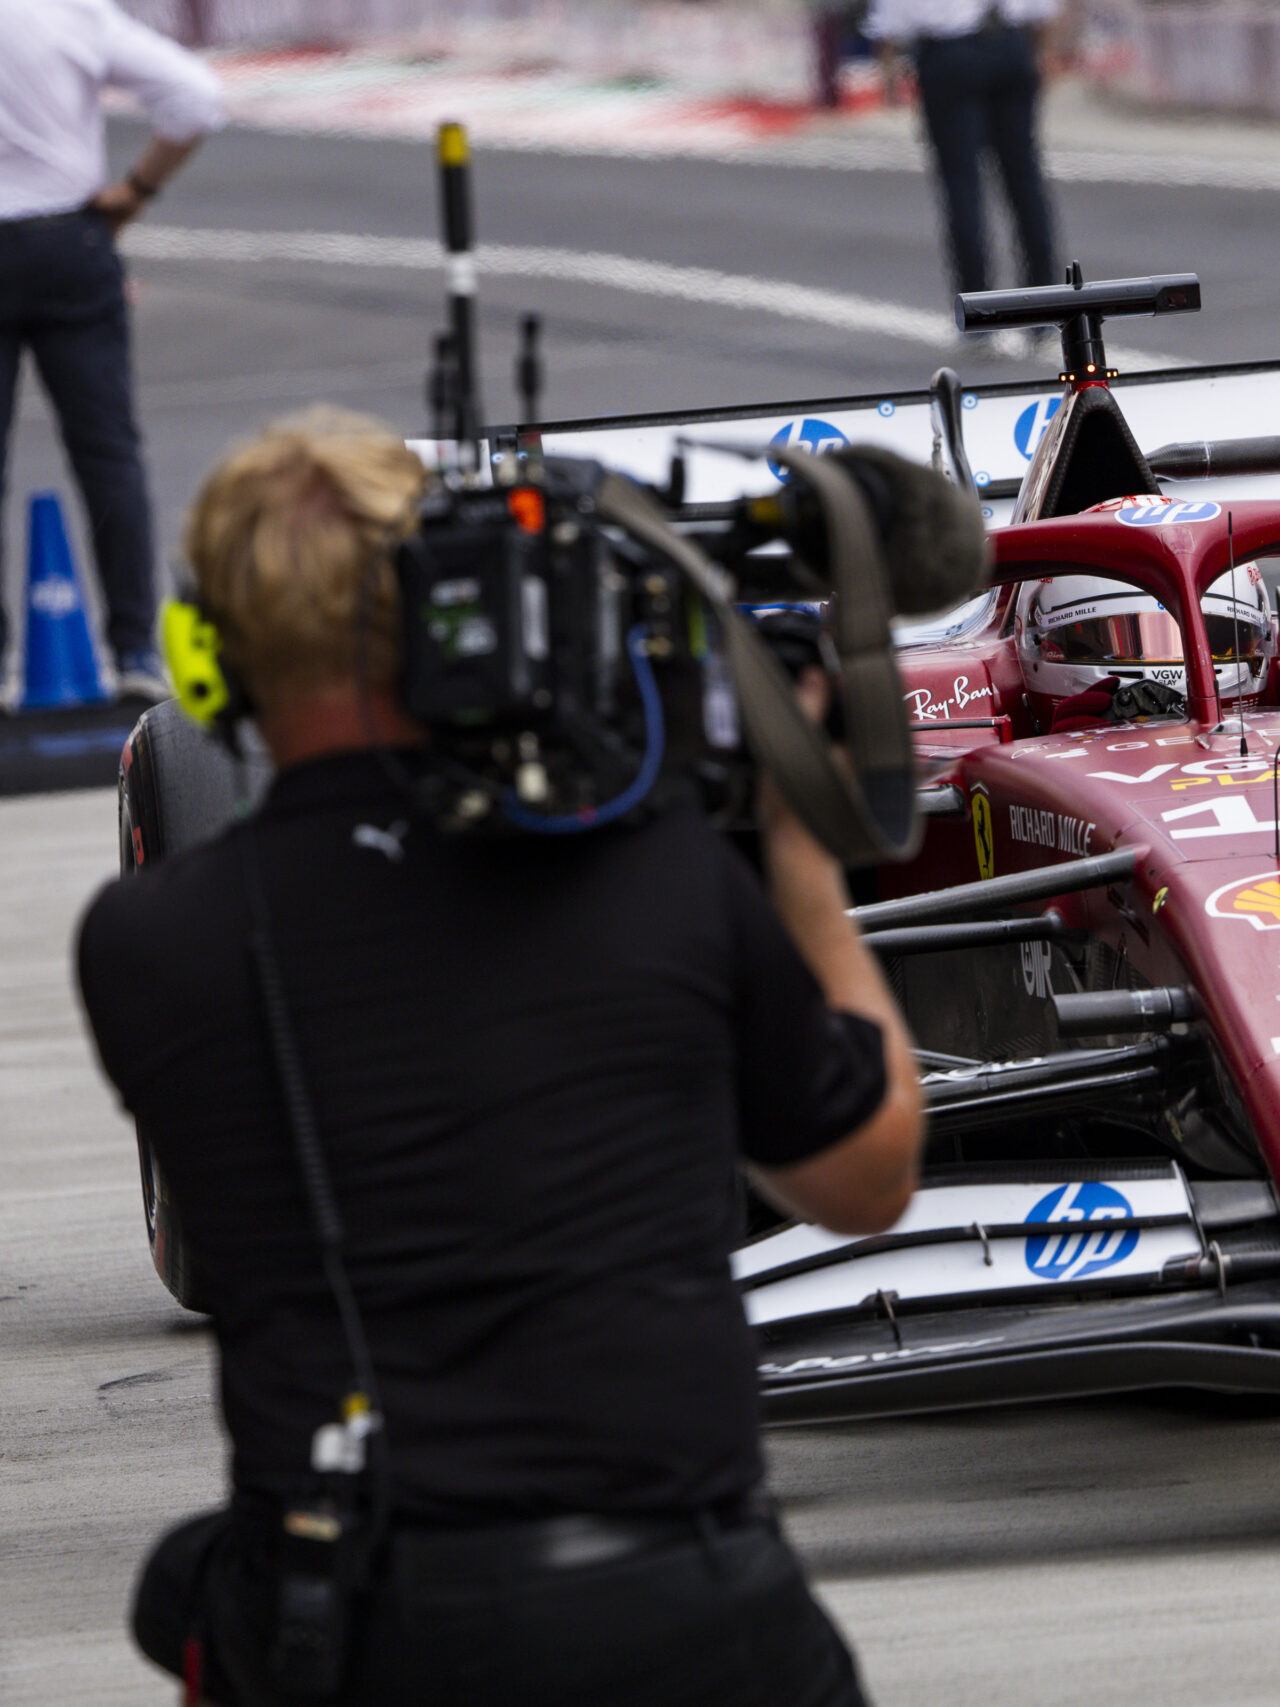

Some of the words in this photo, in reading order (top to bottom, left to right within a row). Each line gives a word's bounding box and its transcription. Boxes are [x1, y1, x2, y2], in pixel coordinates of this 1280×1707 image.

[1048, 612, 1074, 625] RICHARD
[1075, 606, 1097, 617] MILLE
[1151, 669, 1183, 680] VGW
[903, 675, 993, 721] Ray-Ban
[1009, 804, 1056, 849] RICHARD
[1057, 813, 1097, 858] MILLE
[1032, 1181, 1128, 1281] hp
